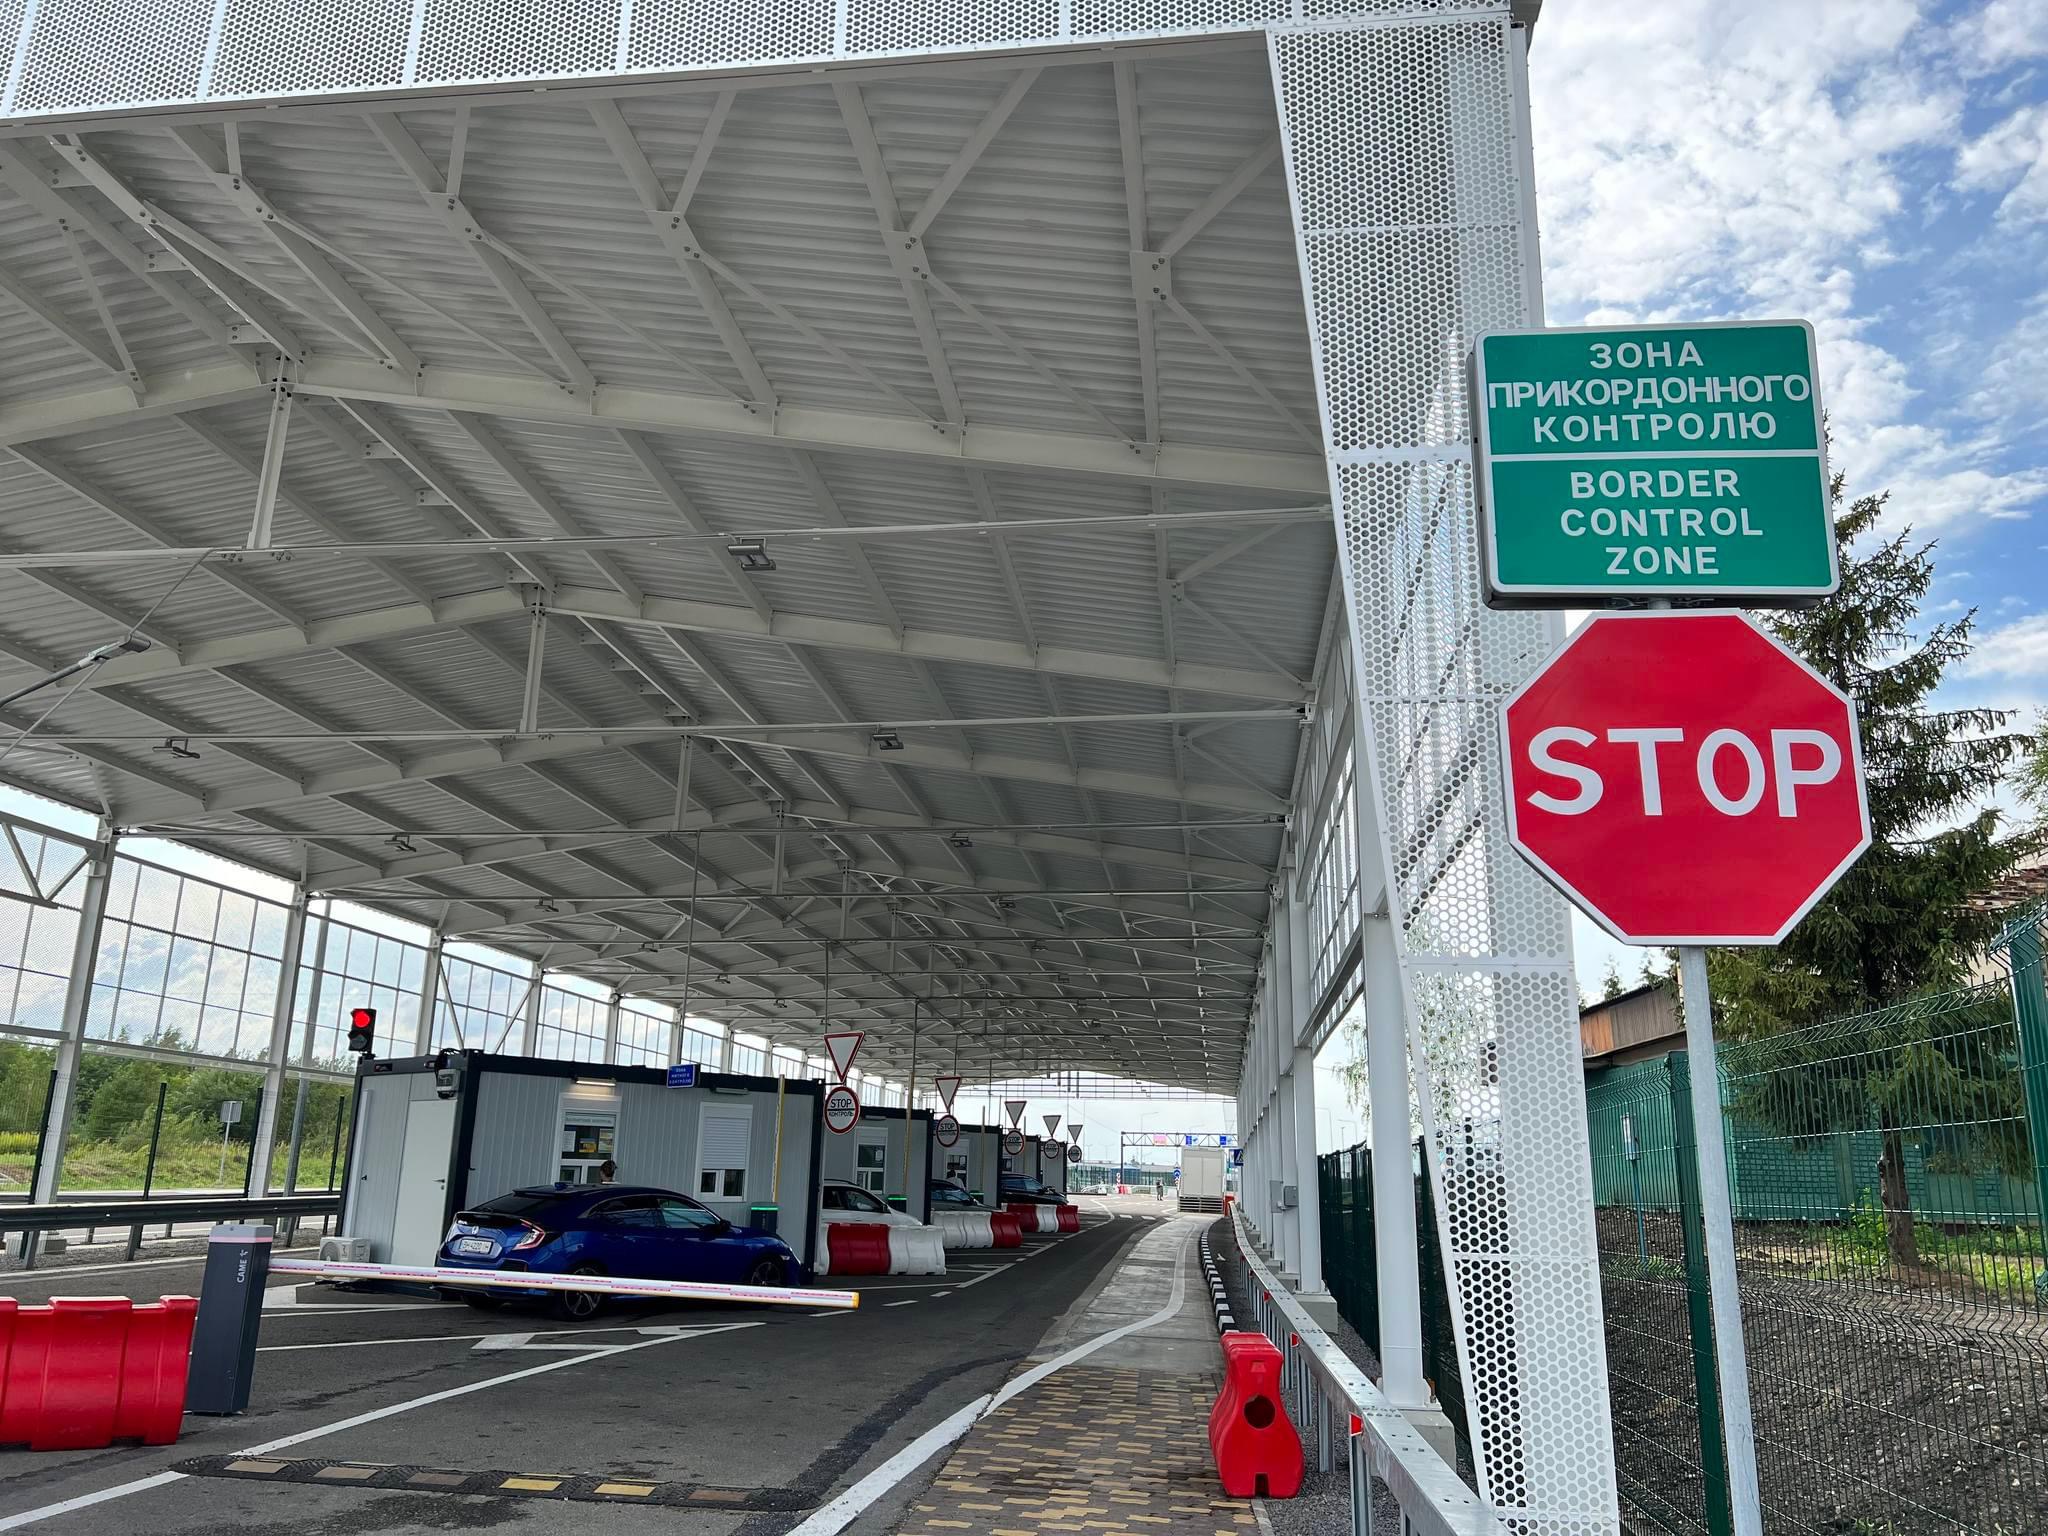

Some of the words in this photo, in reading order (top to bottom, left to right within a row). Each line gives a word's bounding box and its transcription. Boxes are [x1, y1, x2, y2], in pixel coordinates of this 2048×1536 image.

[1590, 340, 1704, 369] ЗОНА
[1488, 374, 1810, 410] ПРИКОРДОННОГО
[1533, 411, 1777, 443] КОНТРОЛЮ
[1570, 469, 1741, 499] BORDER
[1560, 507, 1764, 537] CONTROL
[1605, 546, 1720, 575] ZONE
[1526, 726, 1842, 818] STOP
[830, 1098, 852, 1108] STOP
[940, 1122, 955, 1130] STOP
[236, 1259, 247, 1283] CAME
